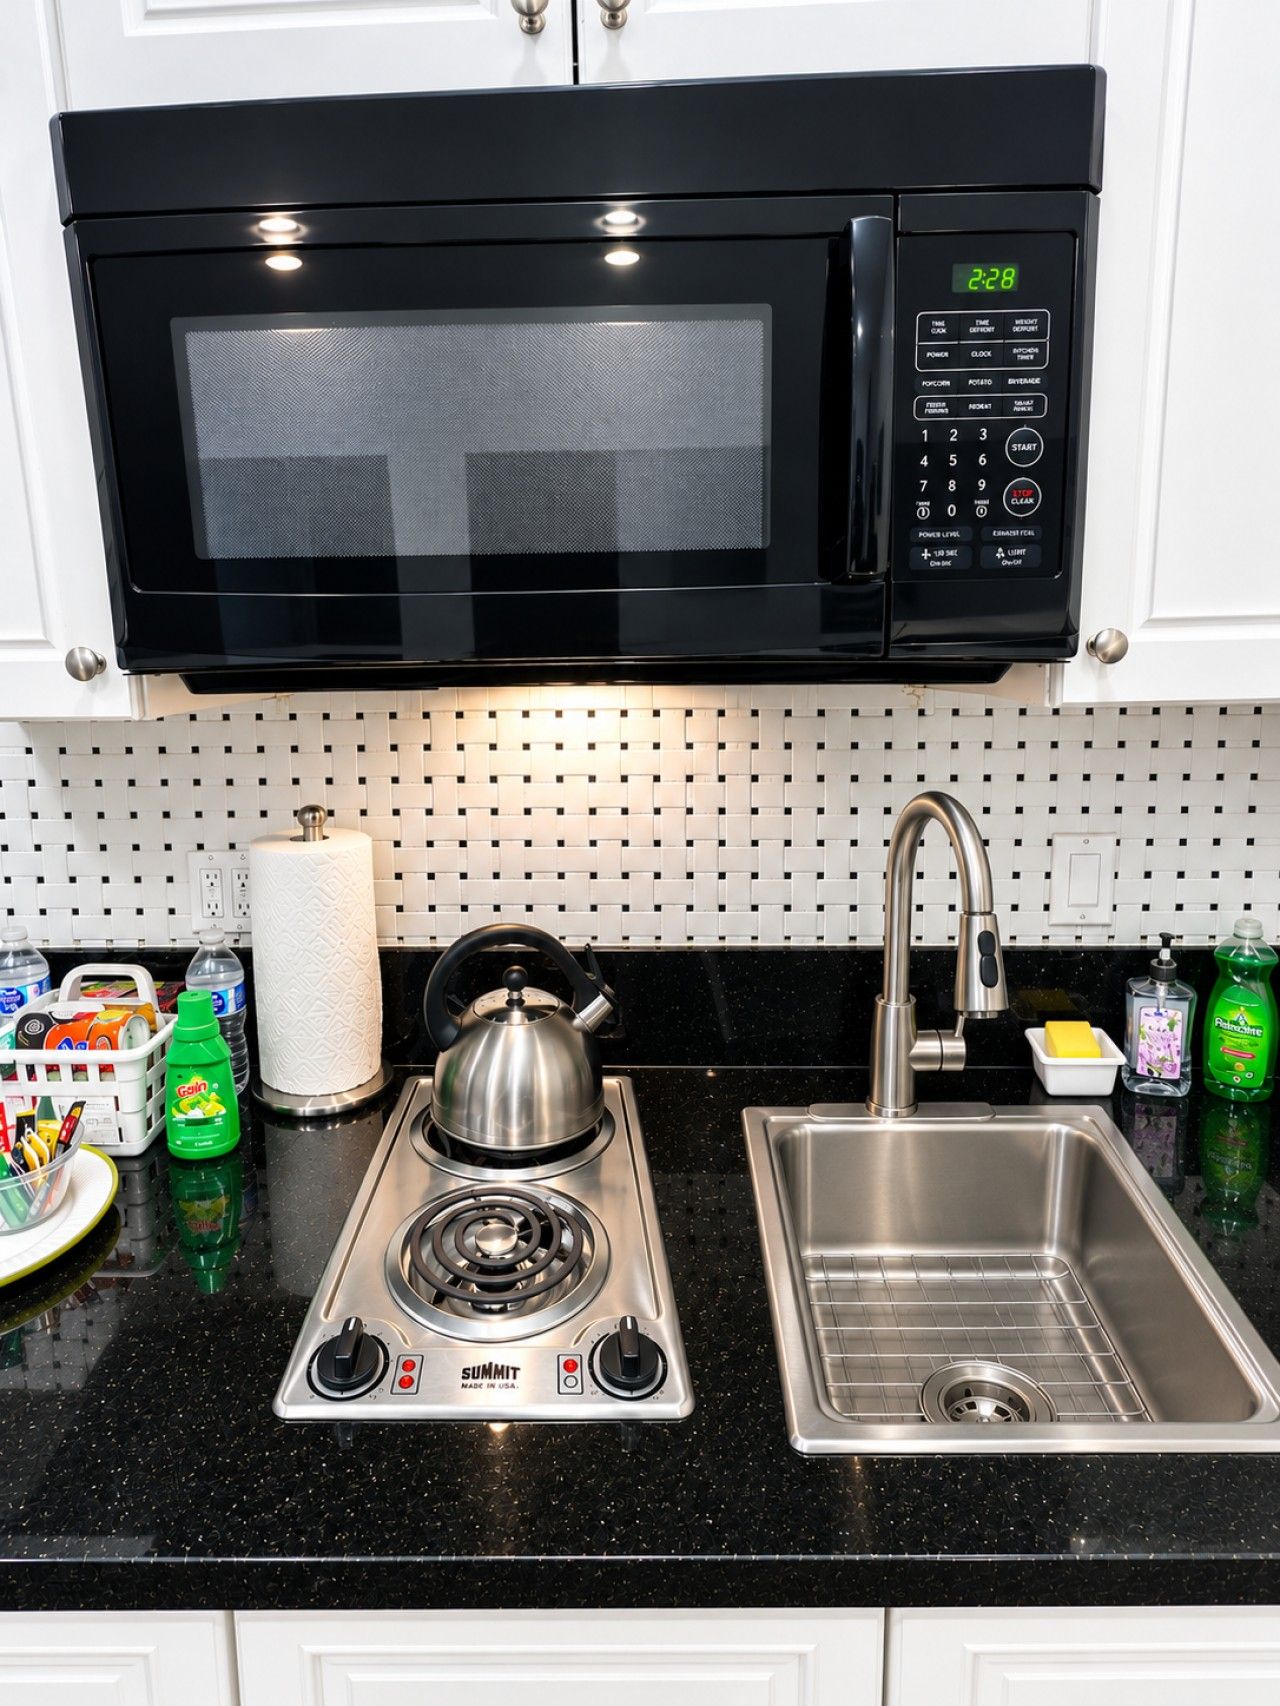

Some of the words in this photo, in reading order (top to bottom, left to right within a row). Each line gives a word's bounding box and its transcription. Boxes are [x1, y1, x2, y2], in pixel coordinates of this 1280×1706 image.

[968, 268, 1016, 290] 2:28
[968, 378, 992, 386] POTATO
[922, 429, 928, 442] 1
[949, 428, 958, 442] 2
[979, 428, 988, 441] 3
[1011, 443, 1037, 451] START
[920, 454, 929, 467] 4
[949, 454, 957, 466] 5
[978, 453, 987, 466] 6
[919, 479, 928, 492] 7
[948, 479, 956, 492] 8
[977, 478, 986, 491] 9
[947, 504, 956, 517] 0
[177, 1081, 208, 1098] Gain
[461, 1361, 521, 1380] SUMMIT
